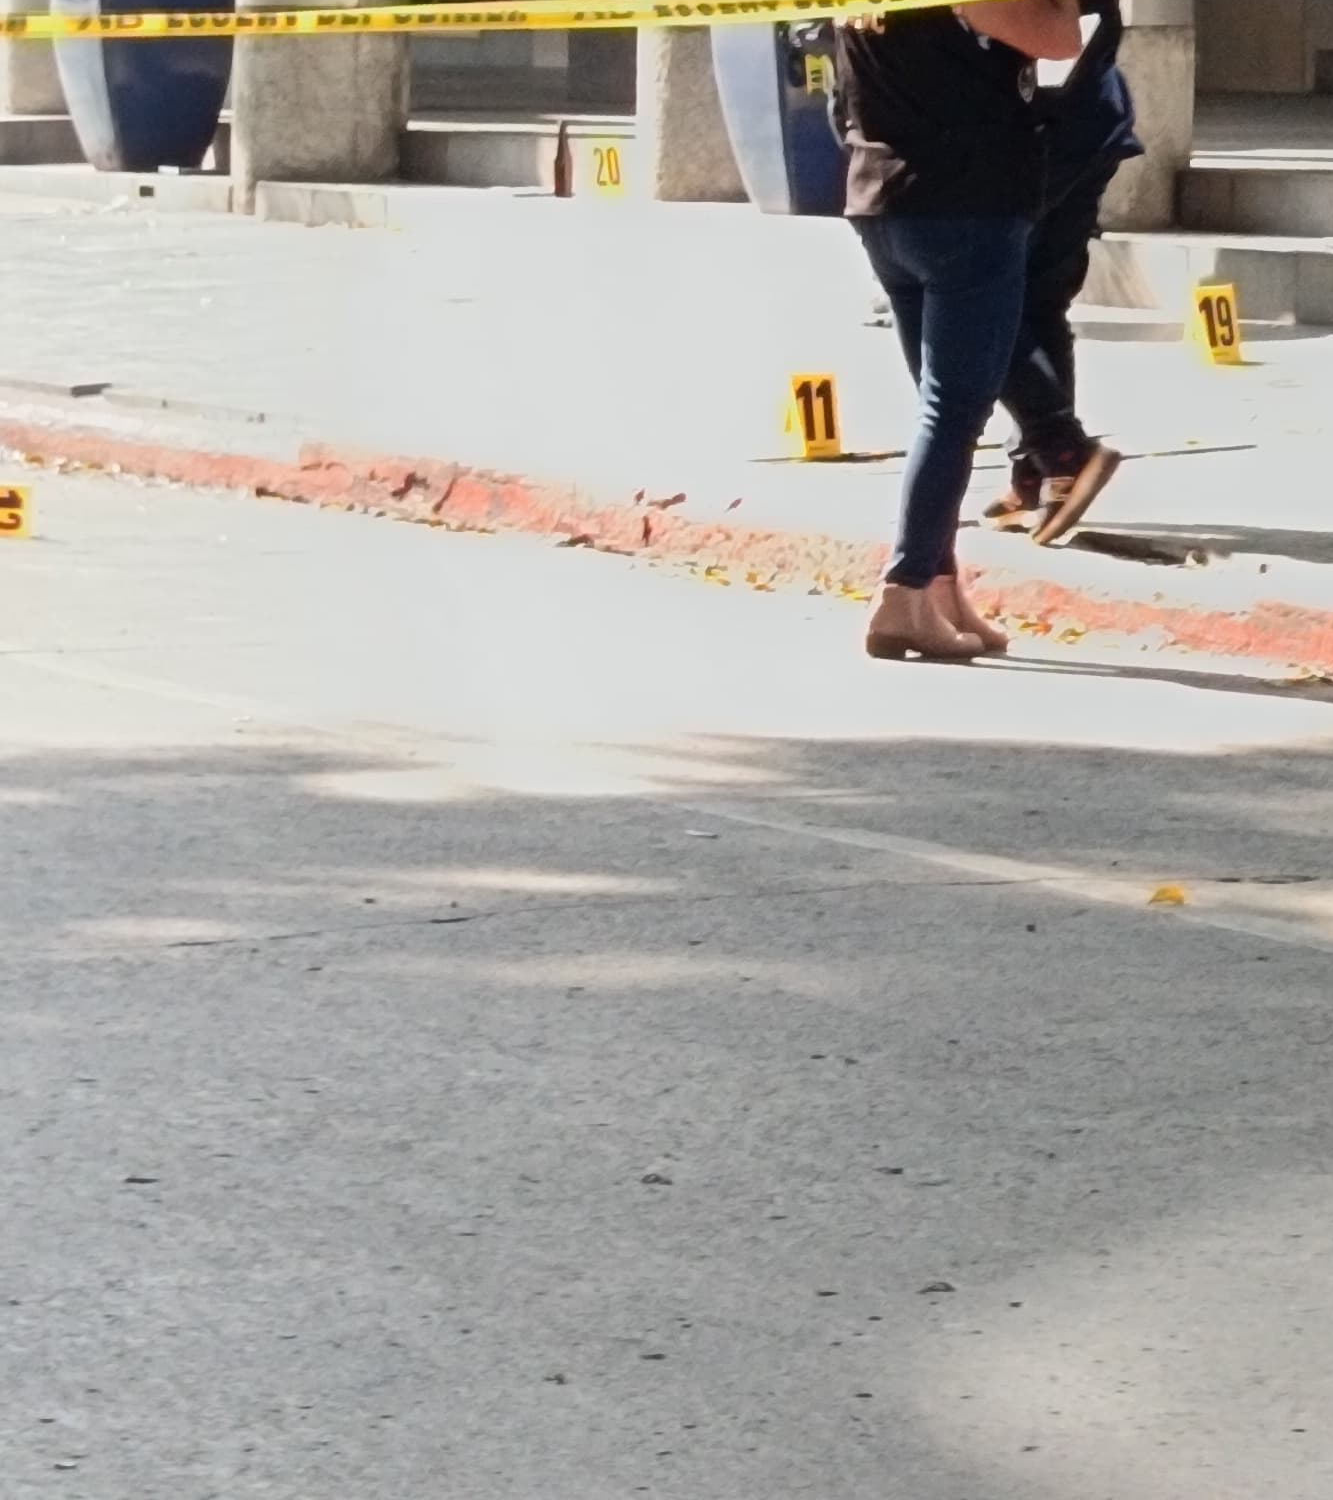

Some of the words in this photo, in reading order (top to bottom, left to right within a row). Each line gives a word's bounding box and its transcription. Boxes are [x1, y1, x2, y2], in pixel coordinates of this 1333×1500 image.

[593, 147, 620, 186] 20
[1199, 295, 1235, 348] 19
[796, 379, 836, 441] 11
